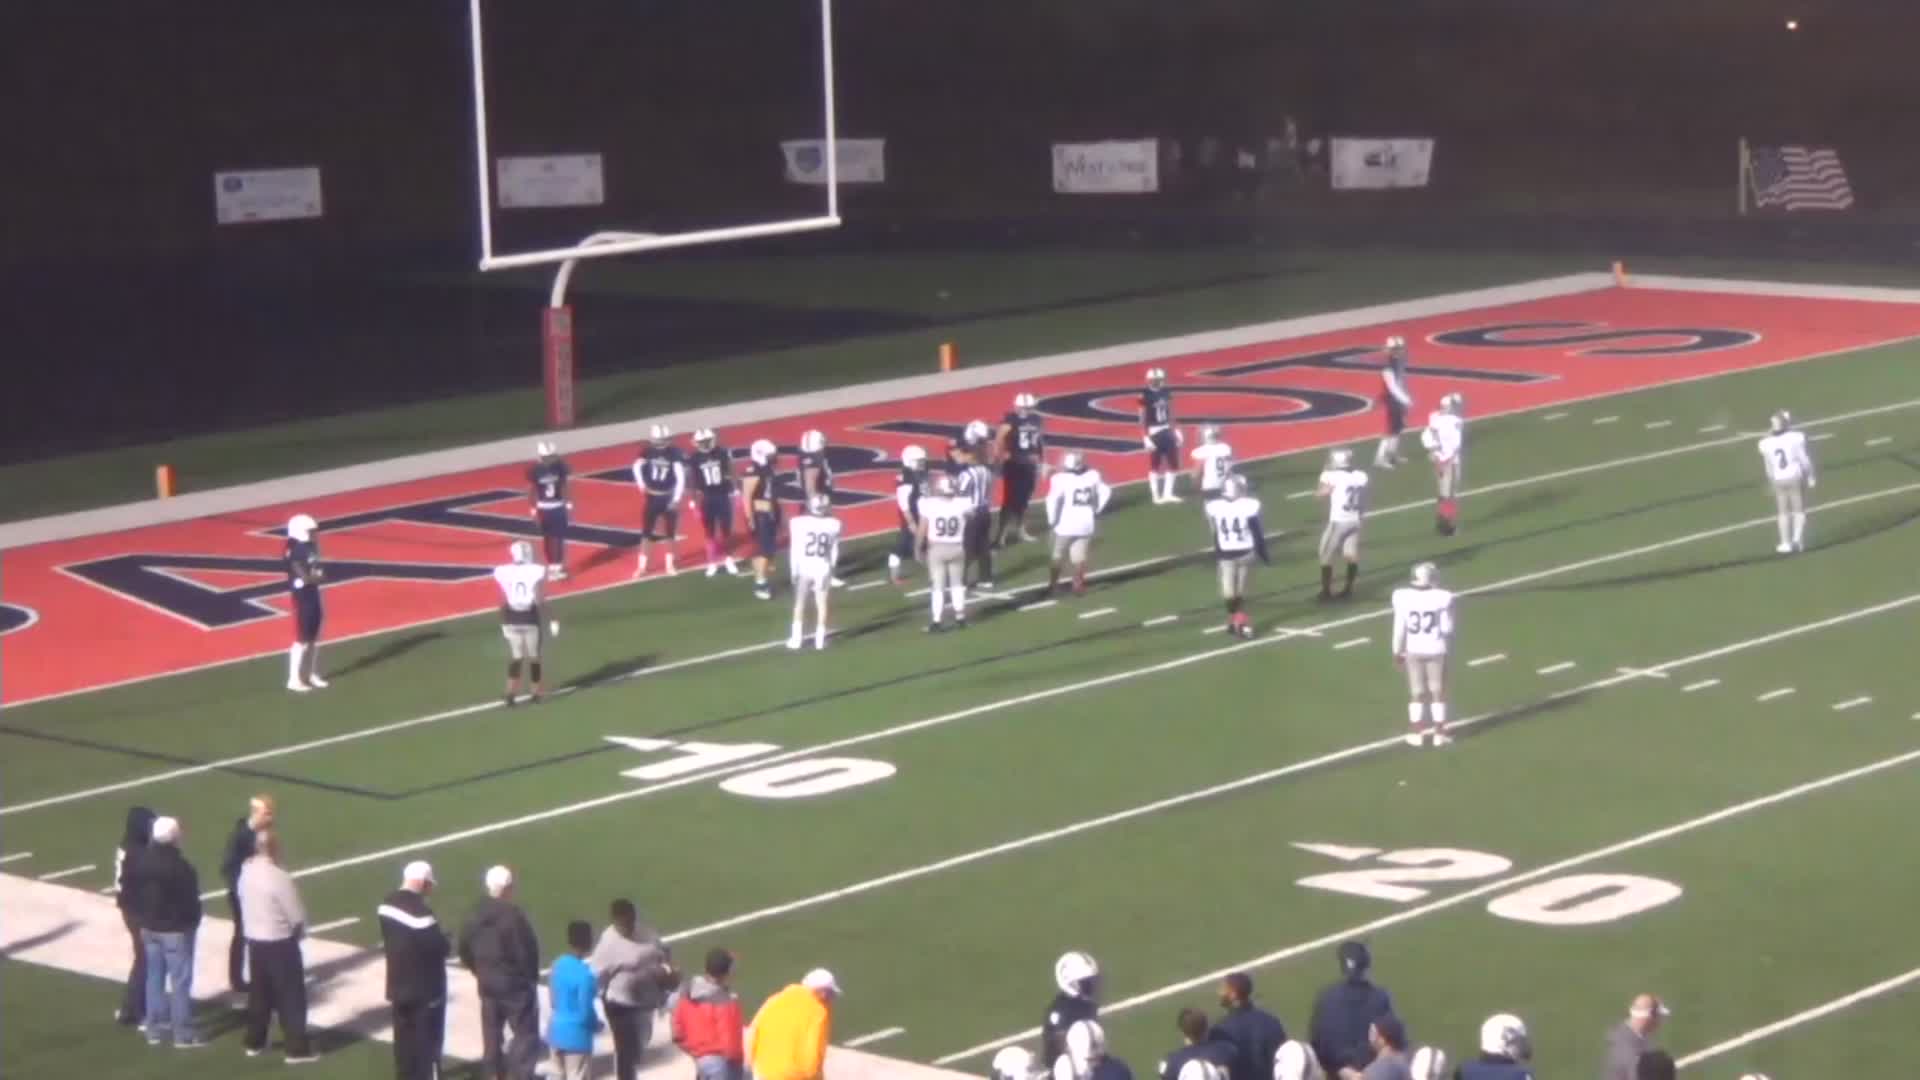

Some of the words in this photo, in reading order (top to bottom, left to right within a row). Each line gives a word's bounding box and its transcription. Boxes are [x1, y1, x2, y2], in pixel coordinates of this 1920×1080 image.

[0, 318, 1763, 634] ATRIOTS
[651, 464, 670, 481] 17
[935, 516, 961, 537] 99
[1220, 516, 1245, 542] 44
[805, 531, 829, 558] 28
[617, 741, 897, 798] 10
[1294, 847, 1684, 925] 20
